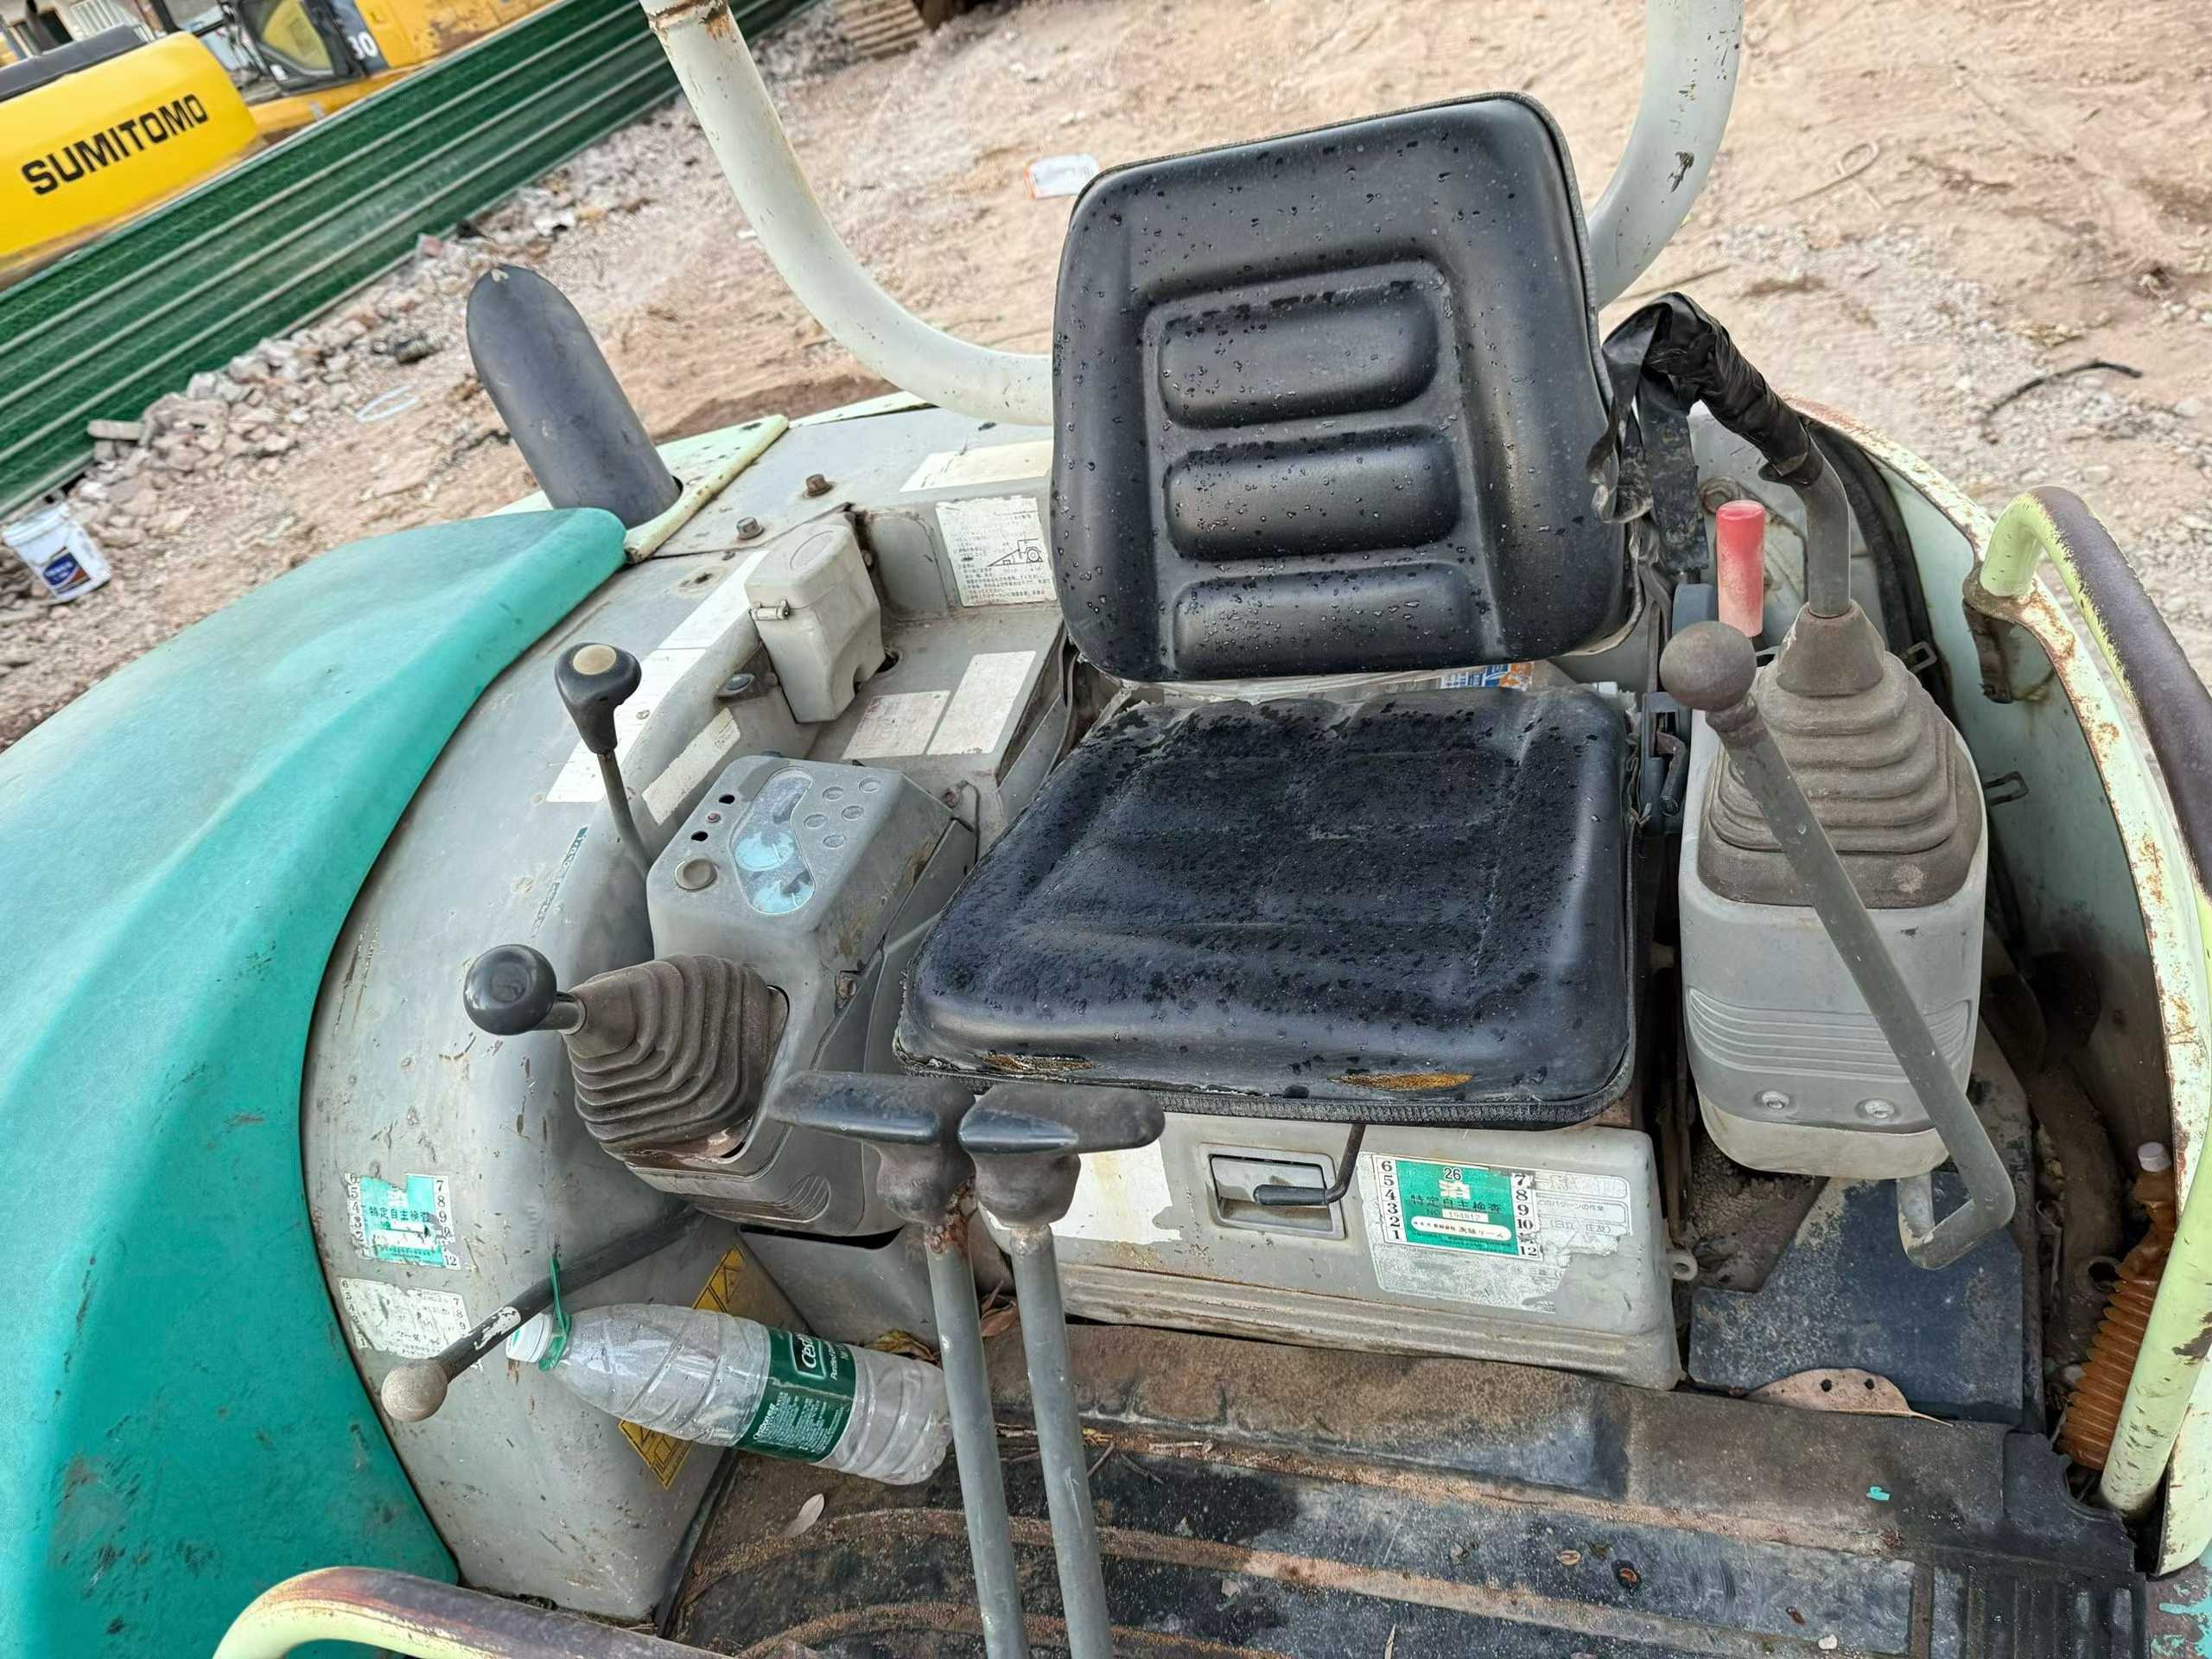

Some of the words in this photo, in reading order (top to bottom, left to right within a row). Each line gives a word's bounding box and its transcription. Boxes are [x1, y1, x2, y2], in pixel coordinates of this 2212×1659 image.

[21, 94, 208, 195] SUMITOMO
[1381, 1160, 1392, 1172] 6
[1444, 1167, 1461, 1180] 26
[1515, 1173, 1526, 1185] 7
[435, 1179, 444, 1192] 7
[1383, 1175, 1395, 1186] 5
[351, 1186, 359, 1198] 5
[1385, 1189, 1396, 1200] 4
[1516, 1189, 1528, 1201] 8
[437, 1195, 446, 1207] 8
[352, 1202, 359, 1213] 4
[1388, 1203, 1398, 1214] 3
[1517, 1204, 1529, 1216] 9
[439, 1211, 448, 1223] 9
[1389, 1216, 1401, 1227] 2
[1517, 1218, 1533, 1230] 10
[1392, 1230, 1400, 1239] 1
[1520, 1246, 1537, 1256] 12
[444, 1255, 457, 1266] 12
[455, 1309, 464, 1319] 8
[459, 1322, 467, 1331] 9
